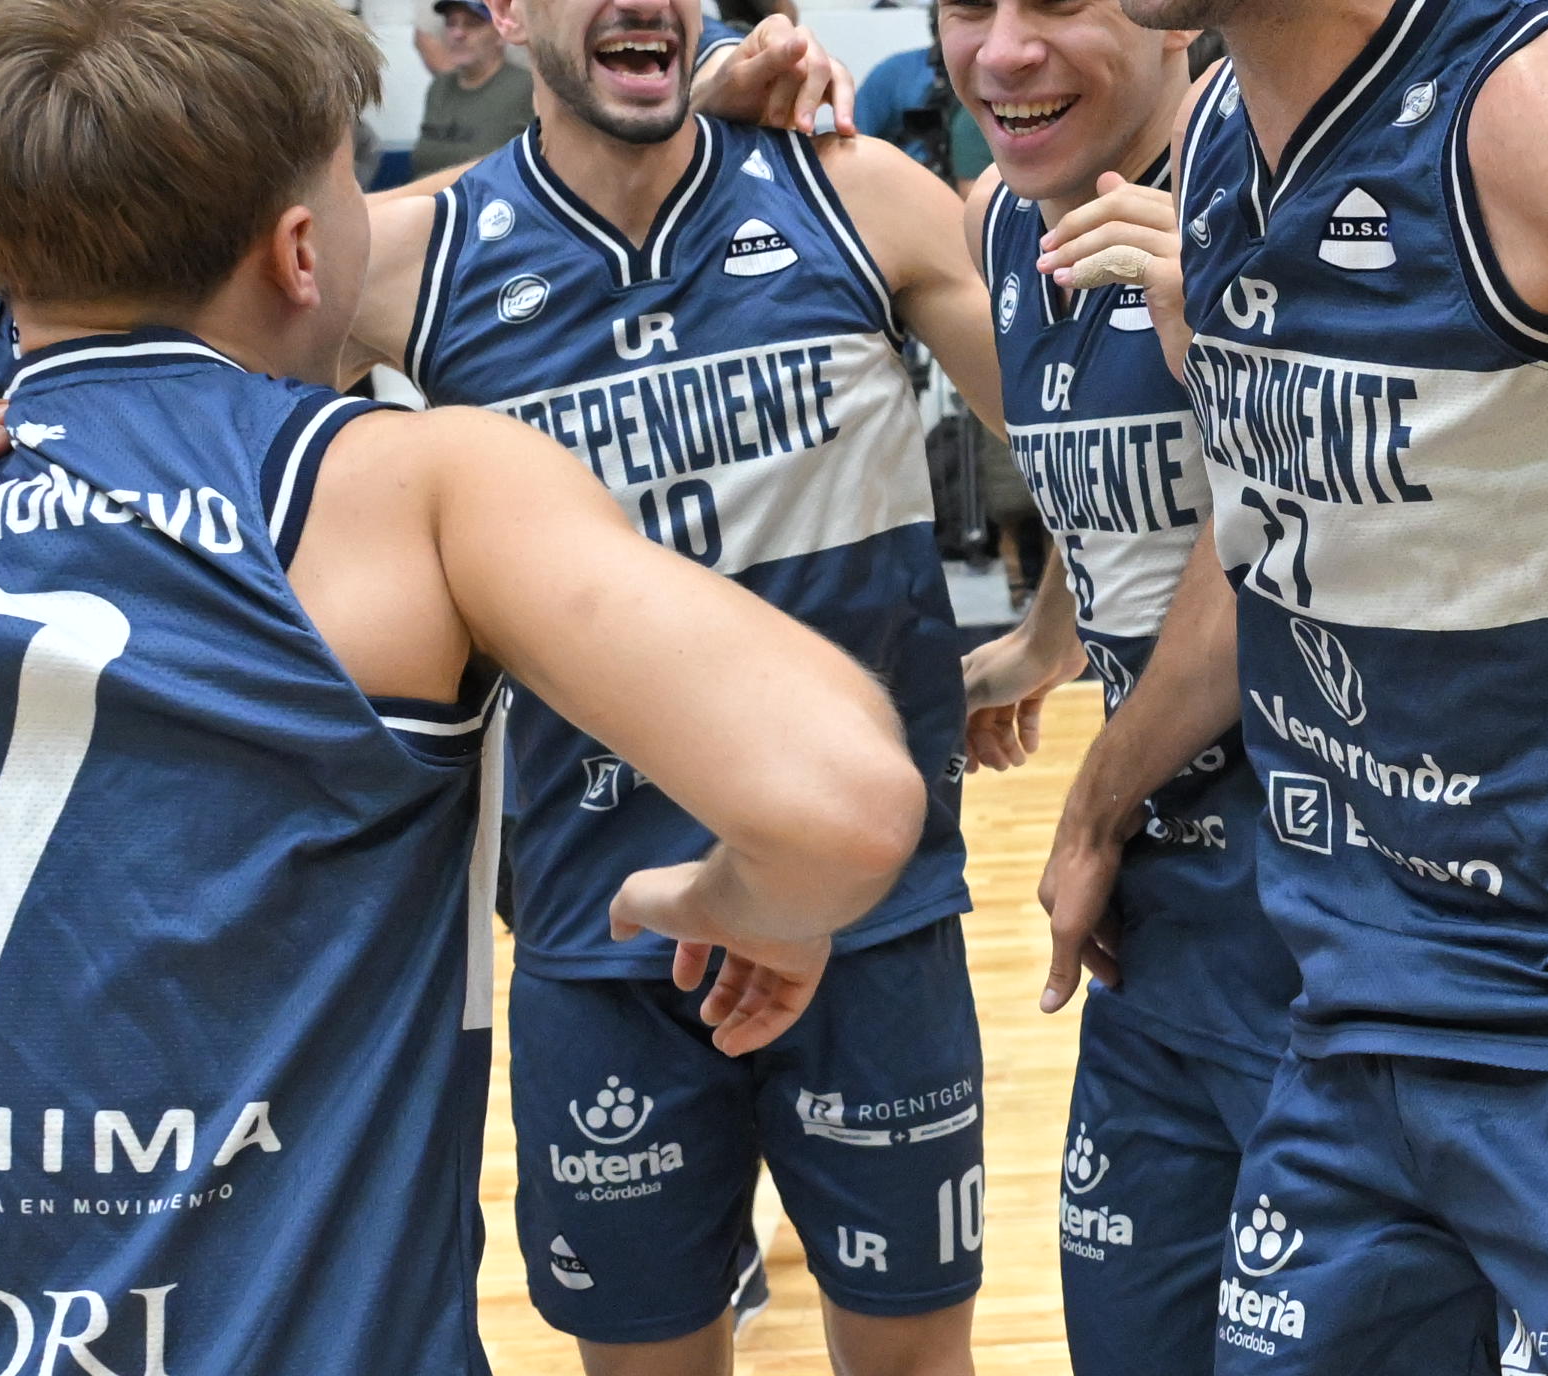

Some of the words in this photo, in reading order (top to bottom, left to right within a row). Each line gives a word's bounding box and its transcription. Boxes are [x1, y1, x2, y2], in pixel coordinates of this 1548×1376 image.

[1249, 688, 1481, 807] Veneranda
[857, 1076, 973, 1124] ROENTGEN
[549, 1140, 685, 1185] lotería
[21, 1198, 55, 1215] EN
[73, 1183, 233, 1216] MOVIMIENTO
[591, 1179, 662, 1203] Córdoba
[1059, 1200, 1133, 1247] tería
[1218, 1276, 1306, 1340] otería
